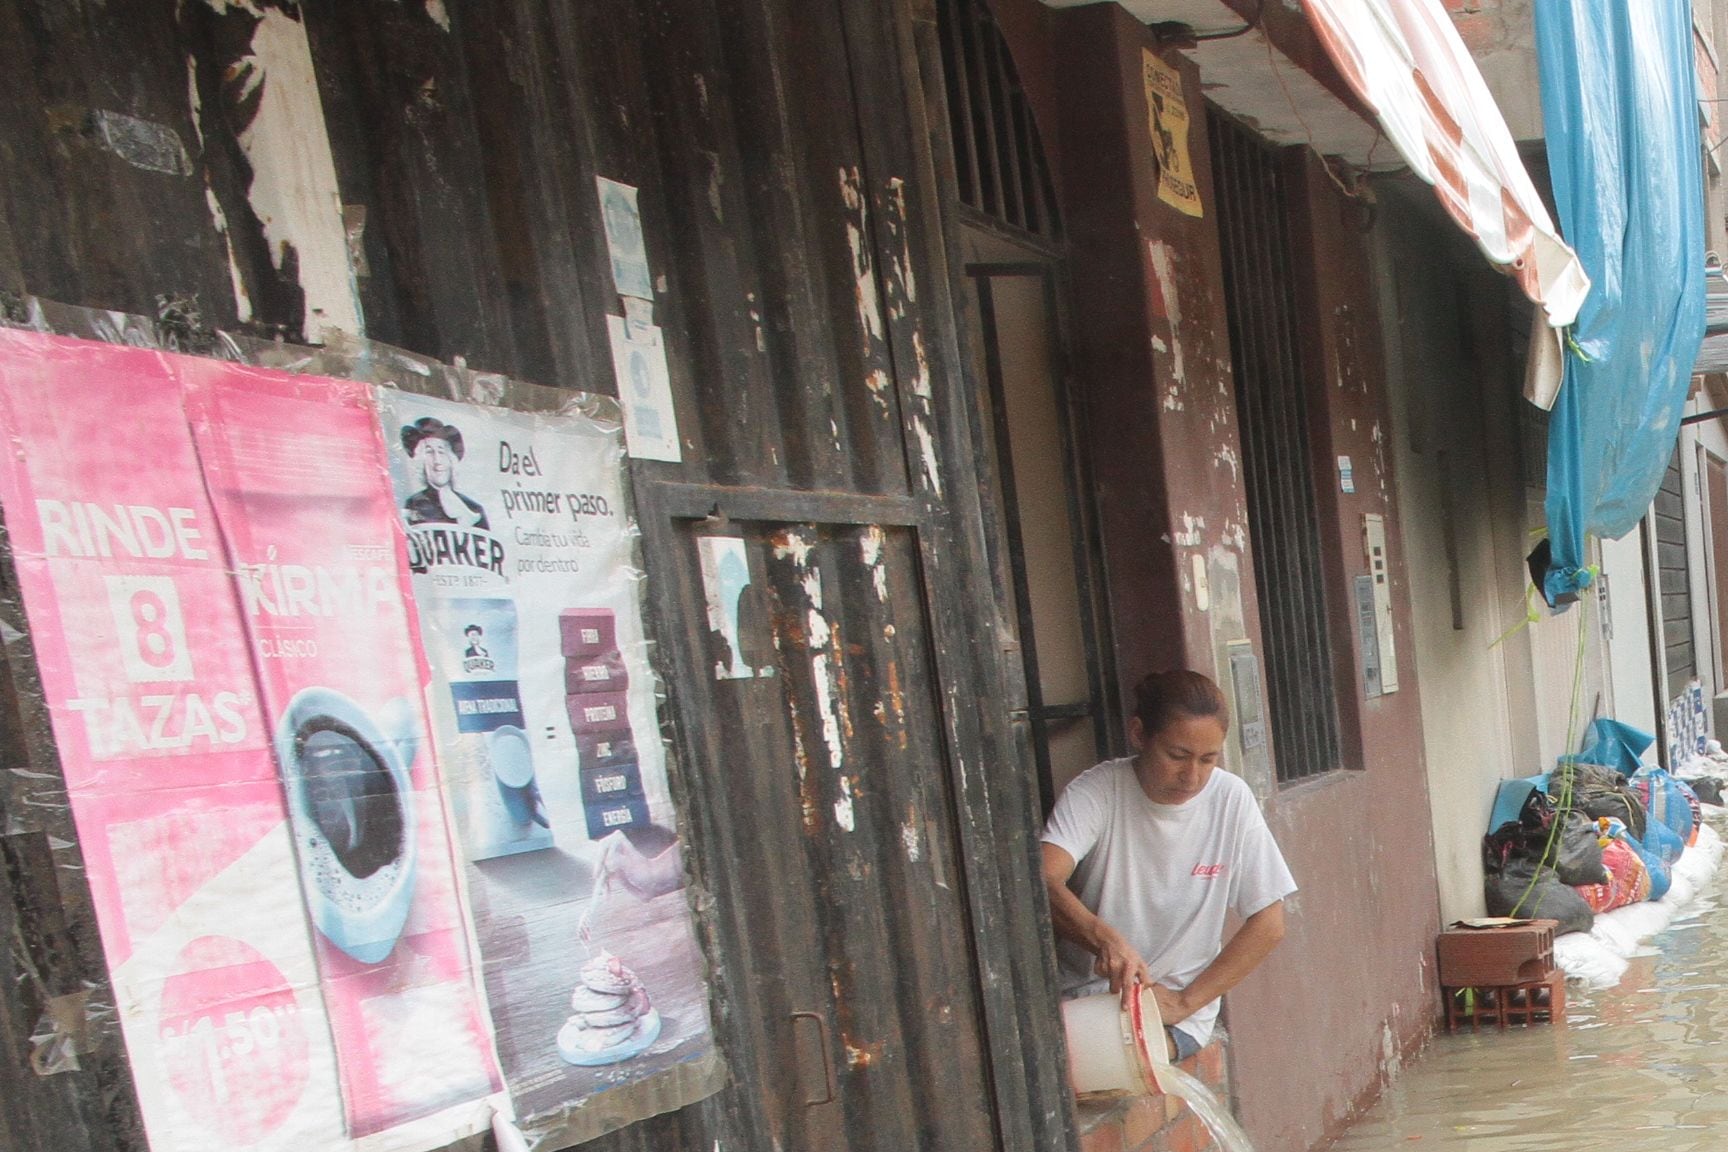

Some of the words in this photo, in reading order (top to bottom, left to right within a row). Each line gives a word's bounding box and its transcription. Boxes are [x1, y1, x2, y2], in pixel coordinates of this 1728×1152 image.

[499, 440, 521, 475] Da
[522, 445, 543, 477] el
[500, 482, 561, 519] primer
[566, 491, 614, 522] paso.
[35, 499, 209, 561] RINDE
[551, 532, 567, 549] tu
[567, 528, 591, 548] vida
[405, 527, 506, 578] QUAKER
[516, 559, 536, 576] por
[536, 557, 580, 573] dentro
[239, 545, 402, 617] KÍRMA
[130, 590, 176, 668] 8
[259, 636, 318, 658] CLÁSICO
[463, 658, 495, 673] QUAKER
